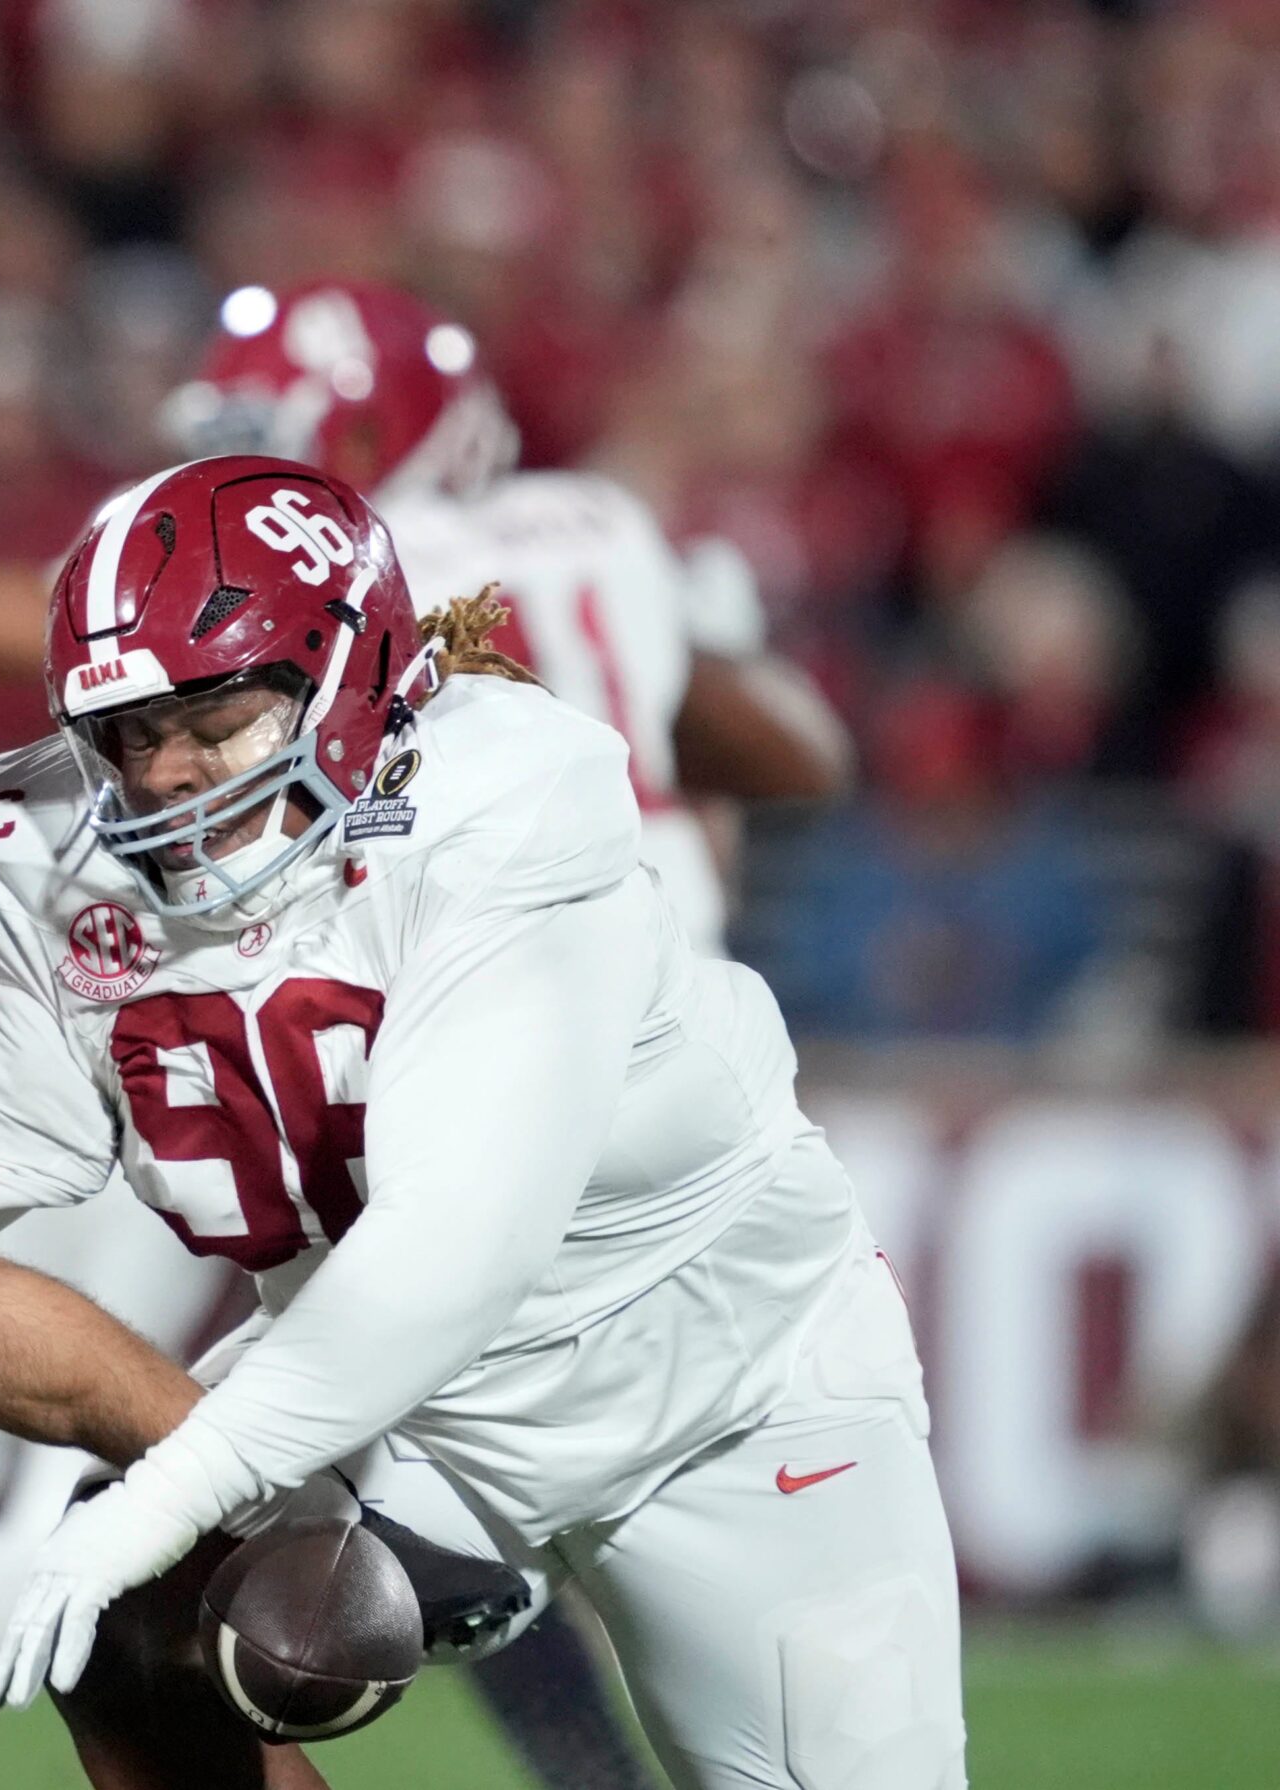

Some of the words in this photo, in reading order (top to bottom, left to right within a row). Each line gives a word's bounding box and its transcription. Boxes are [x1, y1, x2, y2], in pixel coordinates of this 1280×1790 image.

[245, 489, 354, 586] 96
[78, 658, 128, 690] BAMA
[346, 813, 374, 827] FIRST
[376, 810, 414, 822] ROUND
[358, 800, 406, 812] PLAYOFF
[73, 906, 136, 974] SEC
[71, 960, 150, 1000] GRADUATE
[110, 977, 385, 1272] 96
